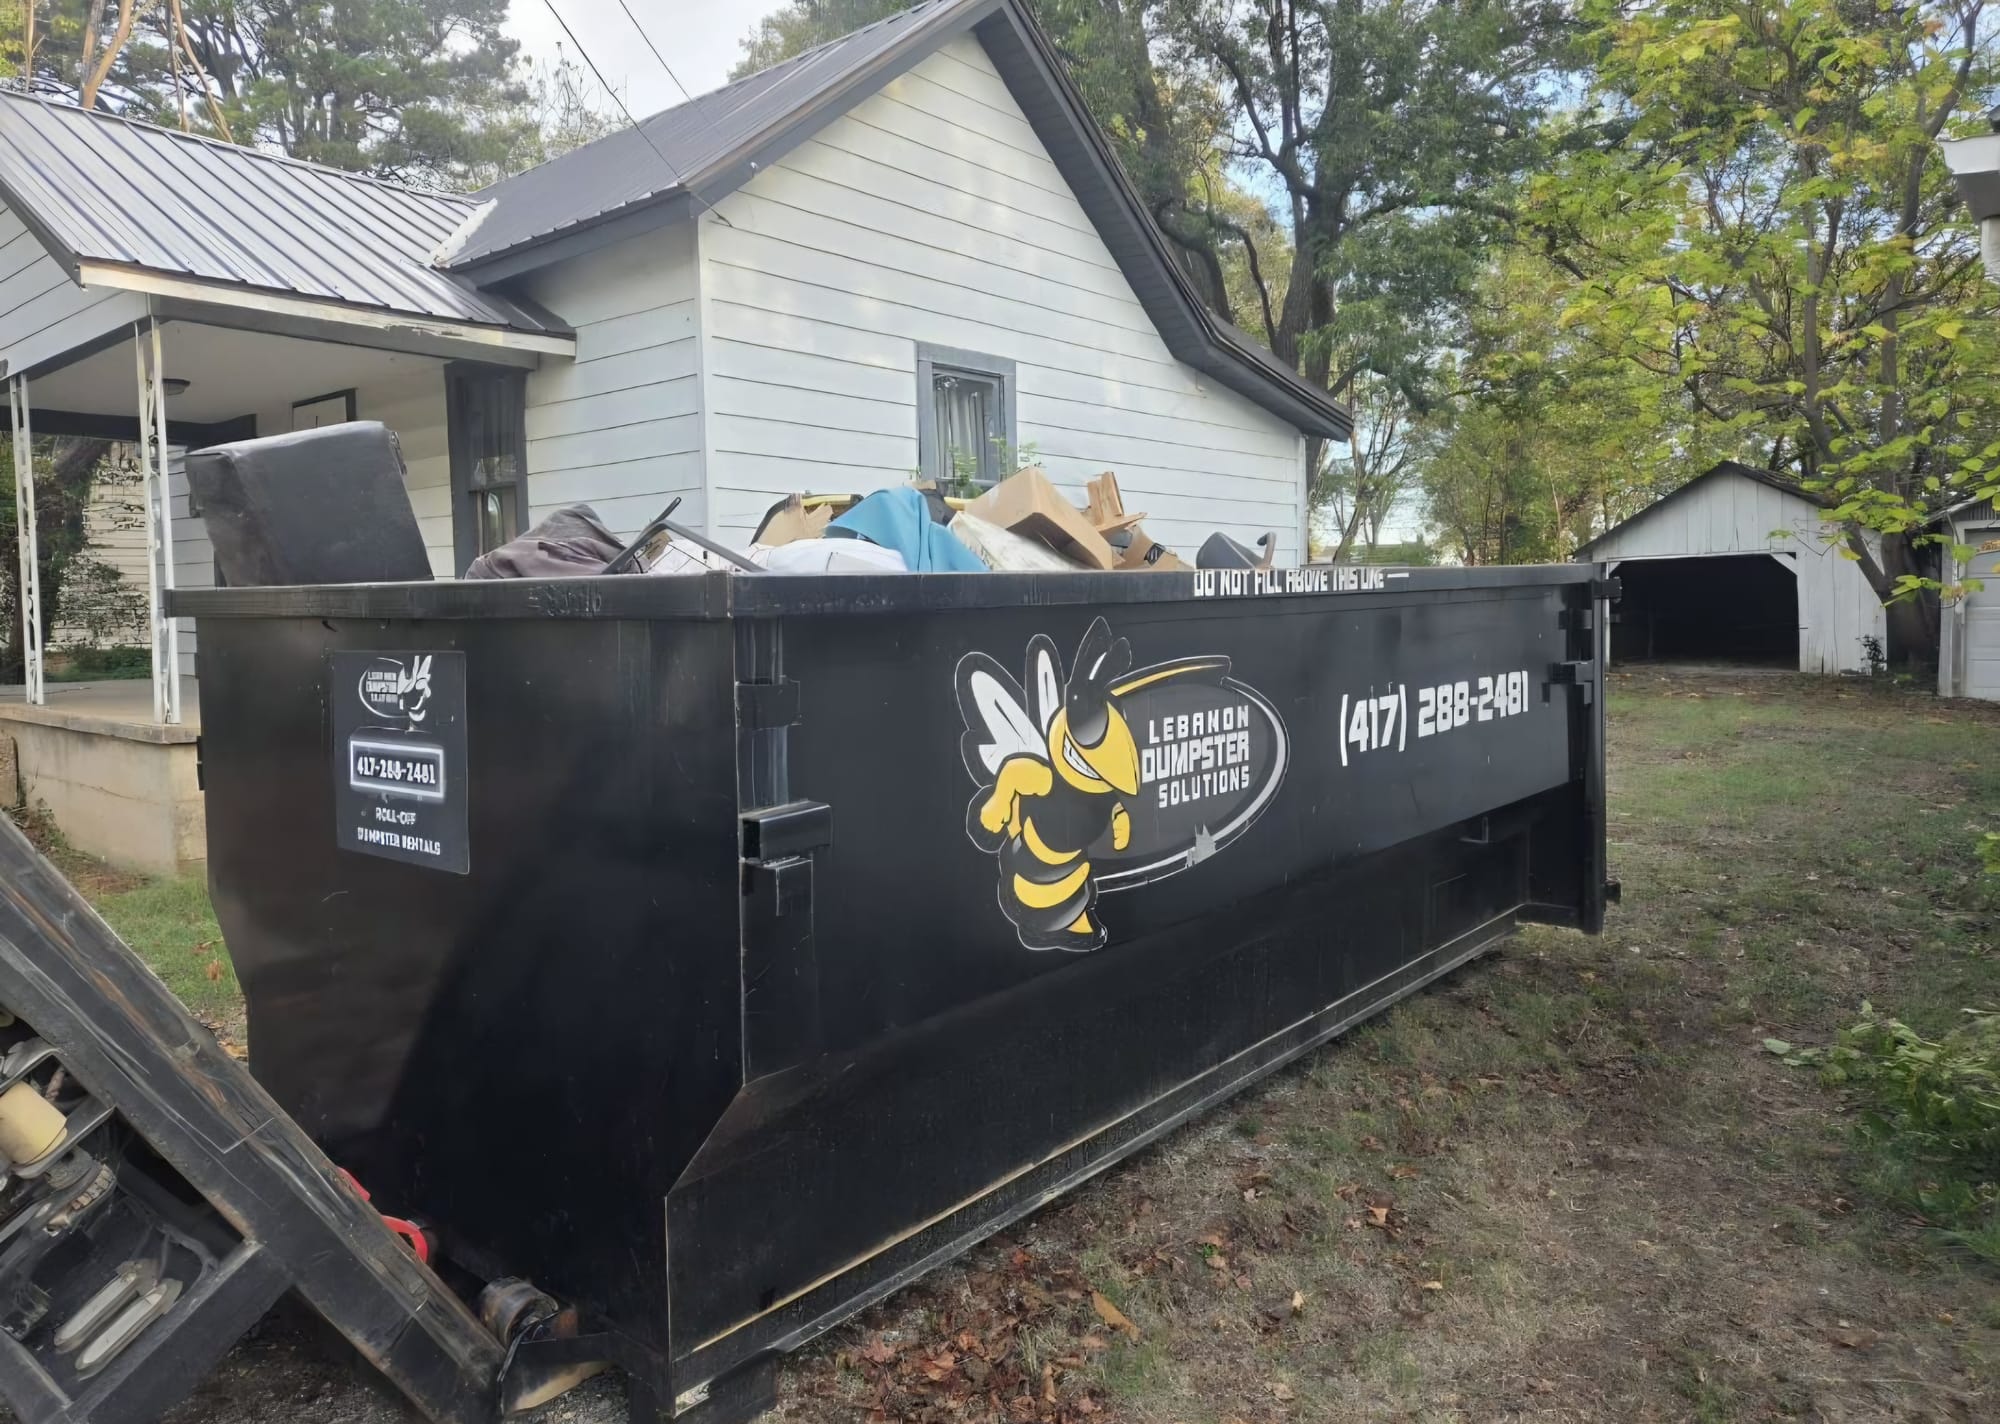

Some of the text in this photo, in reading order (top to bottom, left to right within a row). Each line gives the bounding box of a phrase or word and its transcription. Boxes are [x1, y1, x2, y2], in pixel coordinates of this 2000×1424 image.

[1194, 568, 1215, 596] DO
[1220, 568, 1250, 596] NOT
[1254, 568, 1282, 595] FILL
[1149, 705, 1249, 744] LEBANON
[1340, 670, 1529, 767] (417) 288-2481
[357, 756, 436, 784] 417-288-2481
[1142, 731, 1250, 783] DUMPSTER
[1158, 765, 1250, 808] SOLUTIONS
